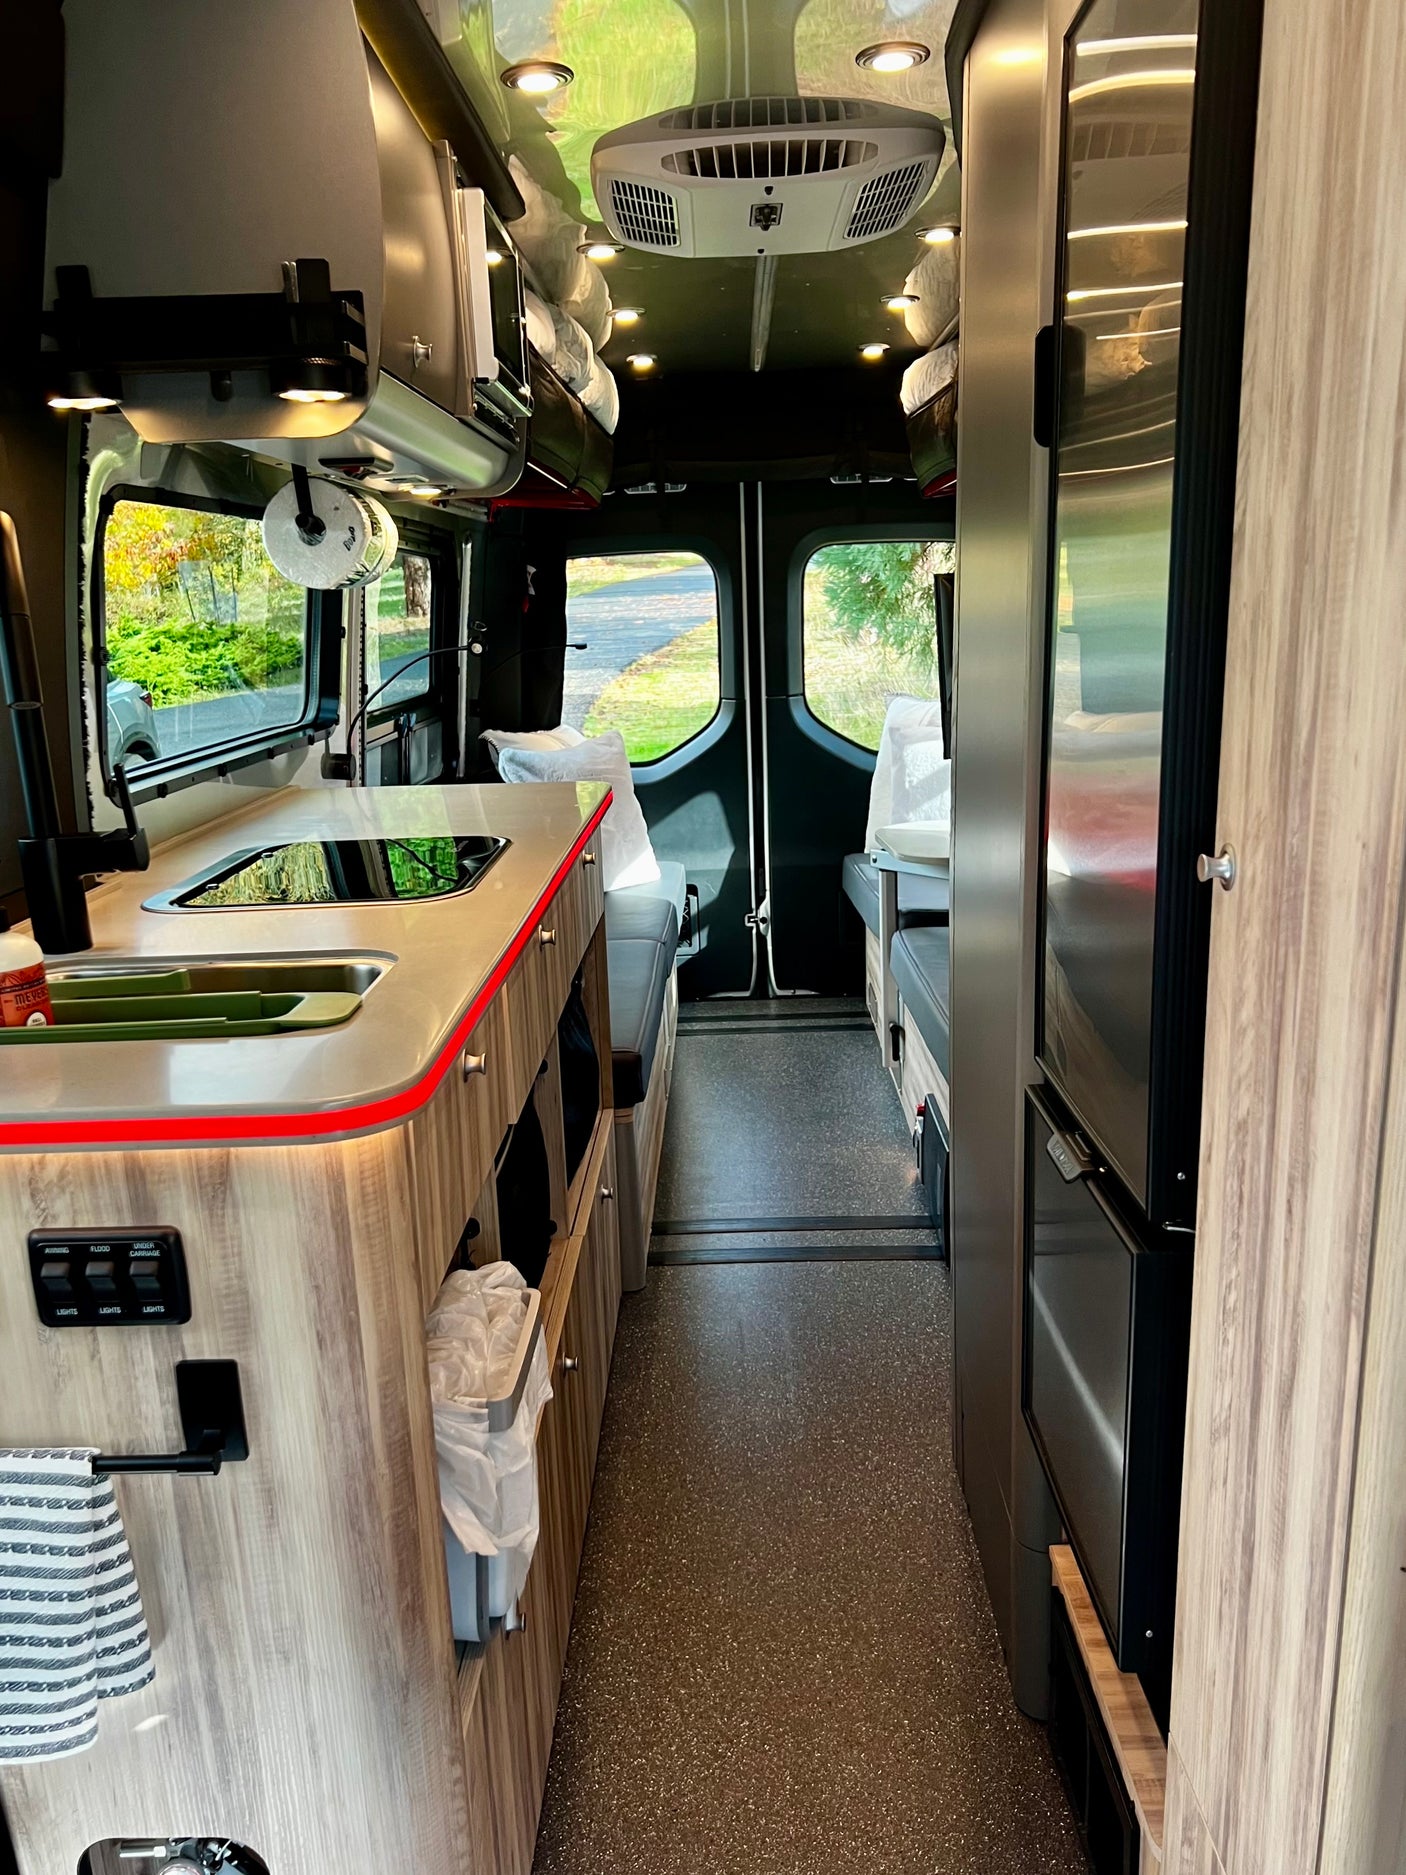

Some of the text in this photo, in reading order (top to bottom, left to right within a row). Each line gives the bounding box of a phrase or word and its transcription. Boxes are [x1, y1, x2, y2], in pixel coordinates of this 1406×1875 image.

[90, 1245, 111, 1253] FLOOD
[133, 1242, 155, 1250] UNDER
[99, 1306, 121, 1314] LIGHTS
[142, 1305, 165, 1313] LIGHTS
